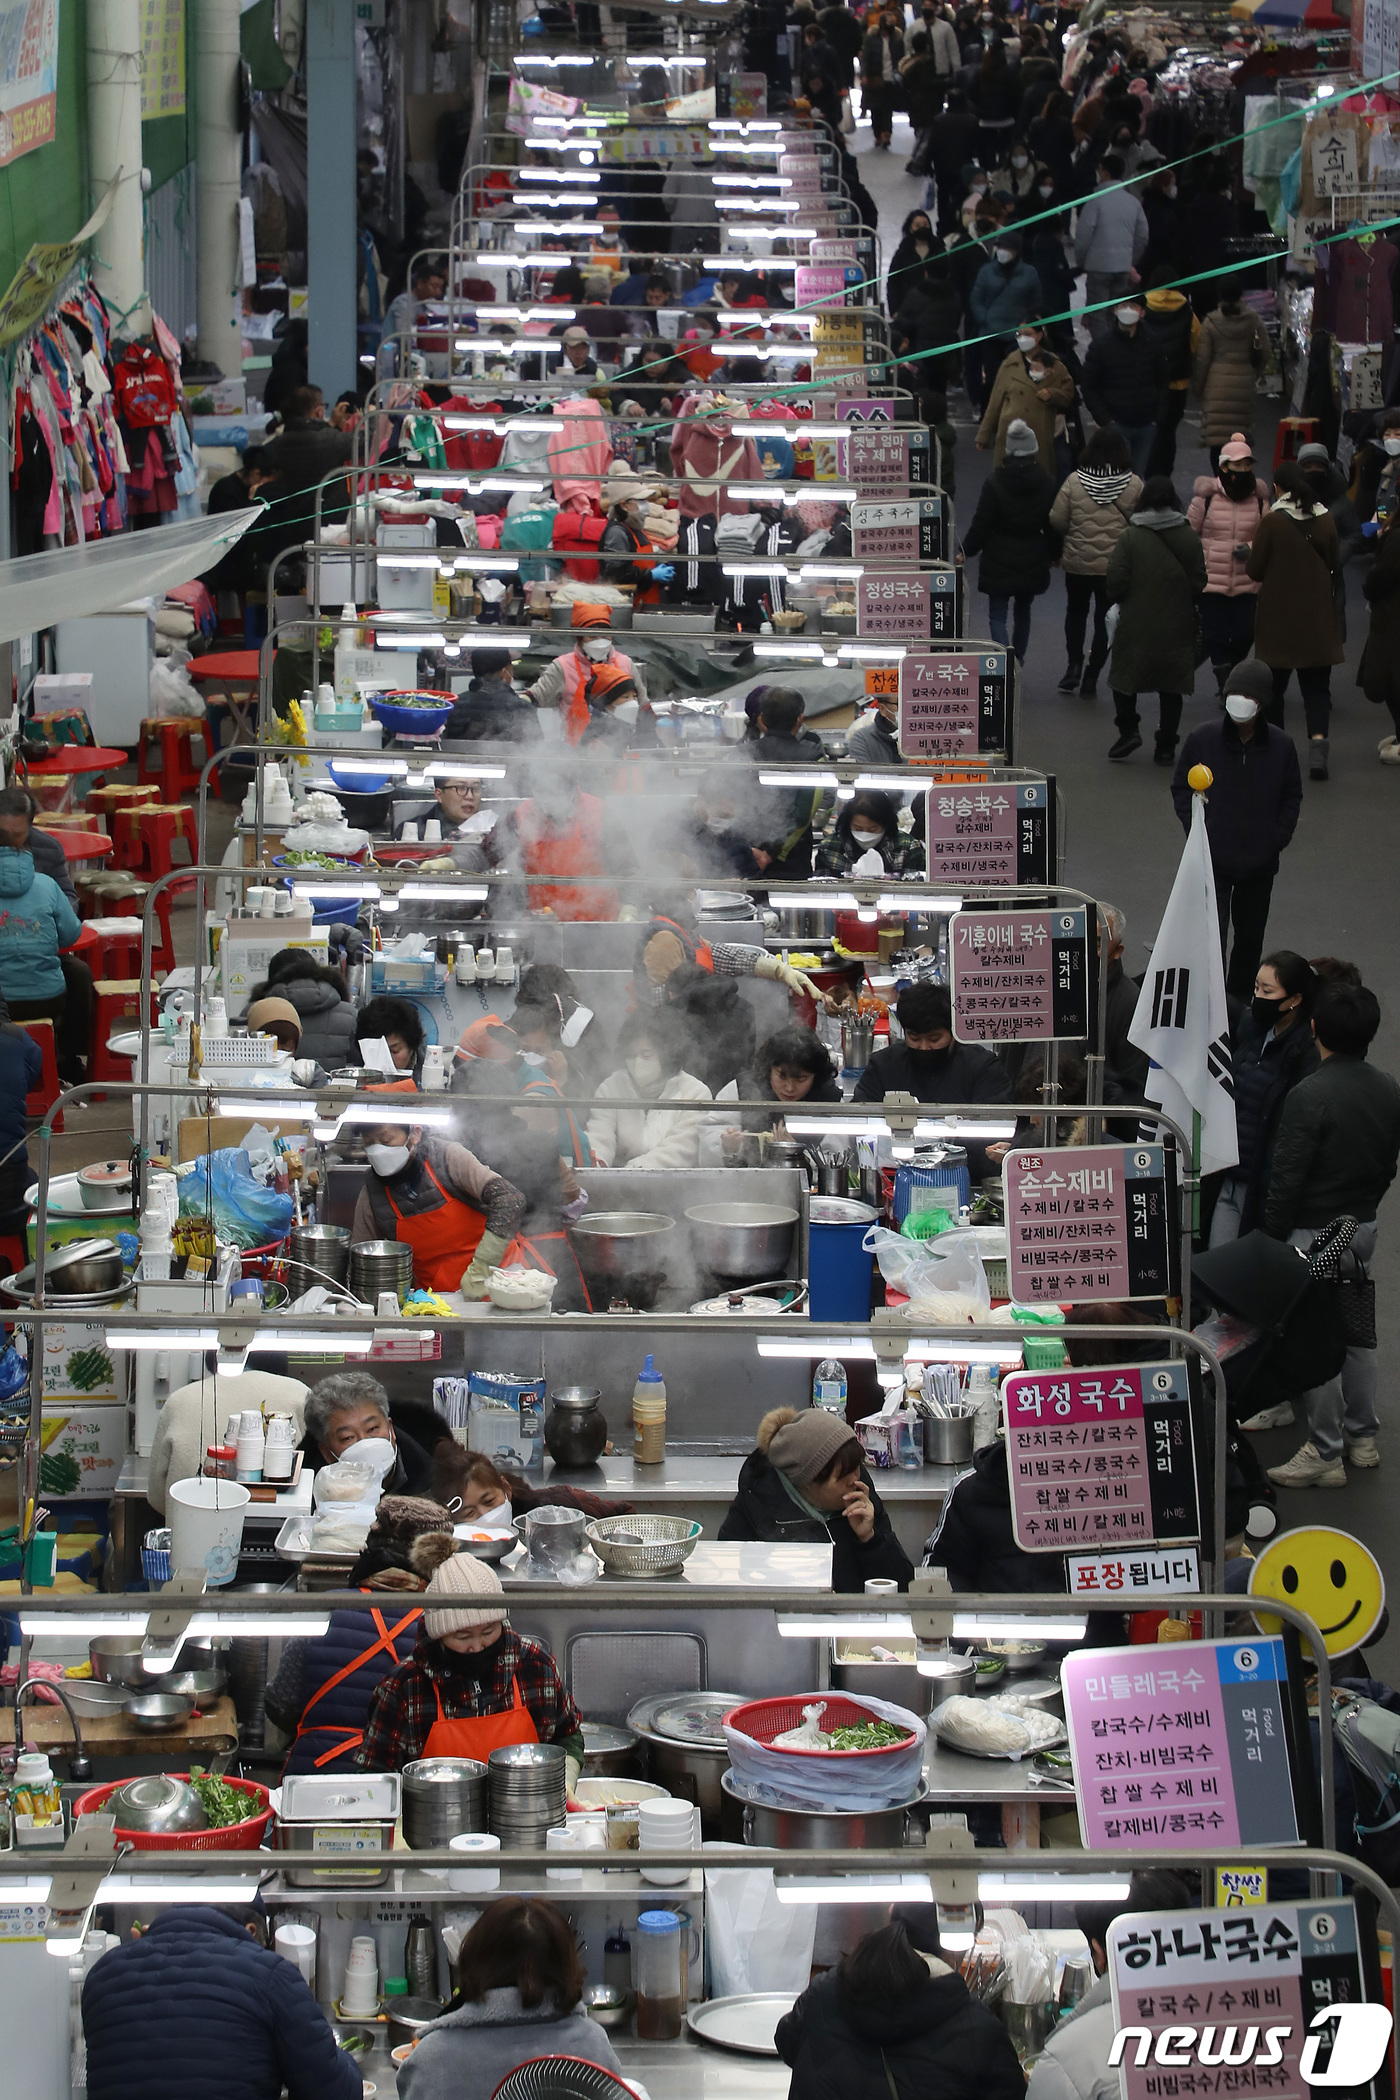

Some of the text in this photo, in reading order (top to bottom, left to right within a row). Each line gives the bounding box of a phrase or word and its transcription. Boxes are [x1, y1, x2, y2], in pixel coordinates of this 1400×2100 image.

[853, 434, 904, 448] 옛날 엄마
[926, 503, 931, 511] 6
[866, 582, 925, 599] 정성국수
[938, 577, 944, 585] 6
[934, 601, 943, 631] 먹거리
[915, 664, 970, 681] 7번 국수
[989, 659, 995, 667] 6
[984, 685, 993, 716] 먹거리
[1028, 790, 1034, 798] 6
[938, 795, 1010, 817] 청송국수
[955, 823, 993, 834] 칼수제비
[1022, 819, 1033, 855] 먹거리
[935, 841, 1014, 854] 칼국수/잔치국수
[940, 860, 1009, 872] 수제비/냉국수
[1063, 918, 1071, 928] 6
[959, 924, 1048, 948] 기훈이네 국수
[980, 954, 1025, 966] 칼수제비
[1072, 951, 1080, 970] Food
[1058, 950, 1070, 990] 먹거리
[960, 974, 1046, 988] 수제비/잔치국수
[966, 996, 1043, 1010] 콩국수/칼국수
[965, 1016, 1045, 1030] 냉국수/비빔국수
[1019, 1157, 1042, 1170] 원조
[1138, 1154, 1146, 1166] 6
[1018, 1167, 1114, 1198] 손수제비
[1020, 1197, 1115, 1216] 수제비/칼국수
[1149, 1193, 1159, 1216] Food
[1132, 1193, 1149, 1240] 먹거리
[1020, 1223, 1117, 1241] 칼제비/잔치국수
[1021, 1247, 1118, 1266] 비빔국수/콩국수
[1137, 1269, 1159, 1280] 小吃
[1158, 1374, 1167, 1388] 6
[1017, 1424, 1138, 1450] 잔치국수/칼국수
[1172, 1419, 1184, 1446] Food
[1153, 1419, 1173, 1474] 먹거리
[1019, 1454, 1141, 1477] 비빔국수/콩국수
[1162, 1507, 1187, 1519] 小吃
[1025, 1511, 1145, 1536] 수제비/칼제비
[1240, 1651, 1252, 1667] 6
[1085, 1667, 1206, 1701] 민들레국수
[1090, 1709, 1211, 1737] 칼국수/수제비
[1262, 1708, 1275, 1737] Food
[1241, 1707, 1263, 1763] 먹거리
[1103, 1810, 1225, 1838] 칼제비/콩국수
[1220, 1872, 1263, 1896] 찹쌀
[1316, 1916, 1329, 1935] 6
[1117, 1917, 1299, 1969] 하나국수
[1137, 1987, 1282, 2018] 칼국수/수제비
[1145, 2066, 1291, 2097] 비빔국수/잔치국수
